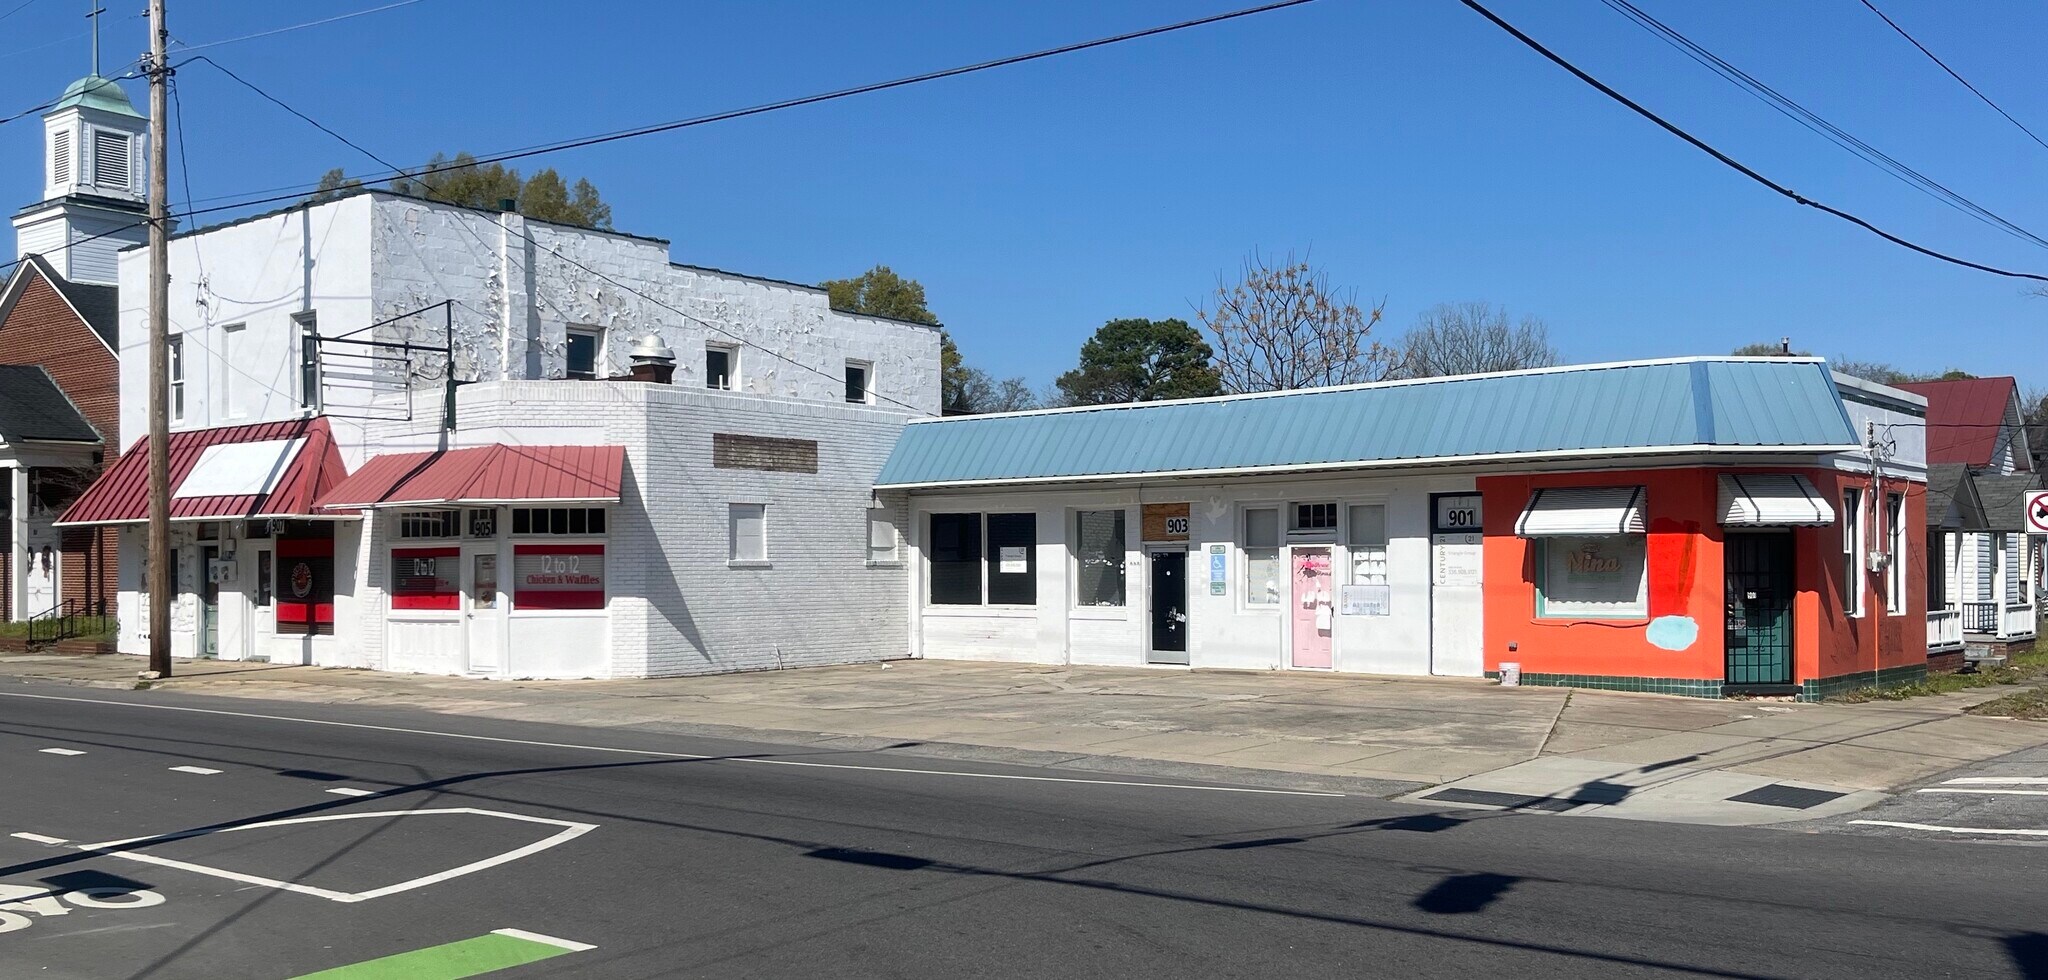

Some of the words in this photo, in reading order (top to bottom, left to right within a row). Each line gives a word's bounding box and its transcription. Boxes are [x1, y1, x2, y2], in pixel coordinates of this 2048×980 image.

[1449, 510, 1474, 526] 901
[272, 519, 284, 532] 907
[475, 522, 491, 536] 905
[1168, 519, 1188, 534] 903
[541, 555, 552, 573] 12
[554, 558, 565, 573] to
[569, 555, 580, 573] 12
[527, 574, 556, 584] Chicken
[557, 574, 563, 584] &
[565, 574, 600, 584] Waffles
